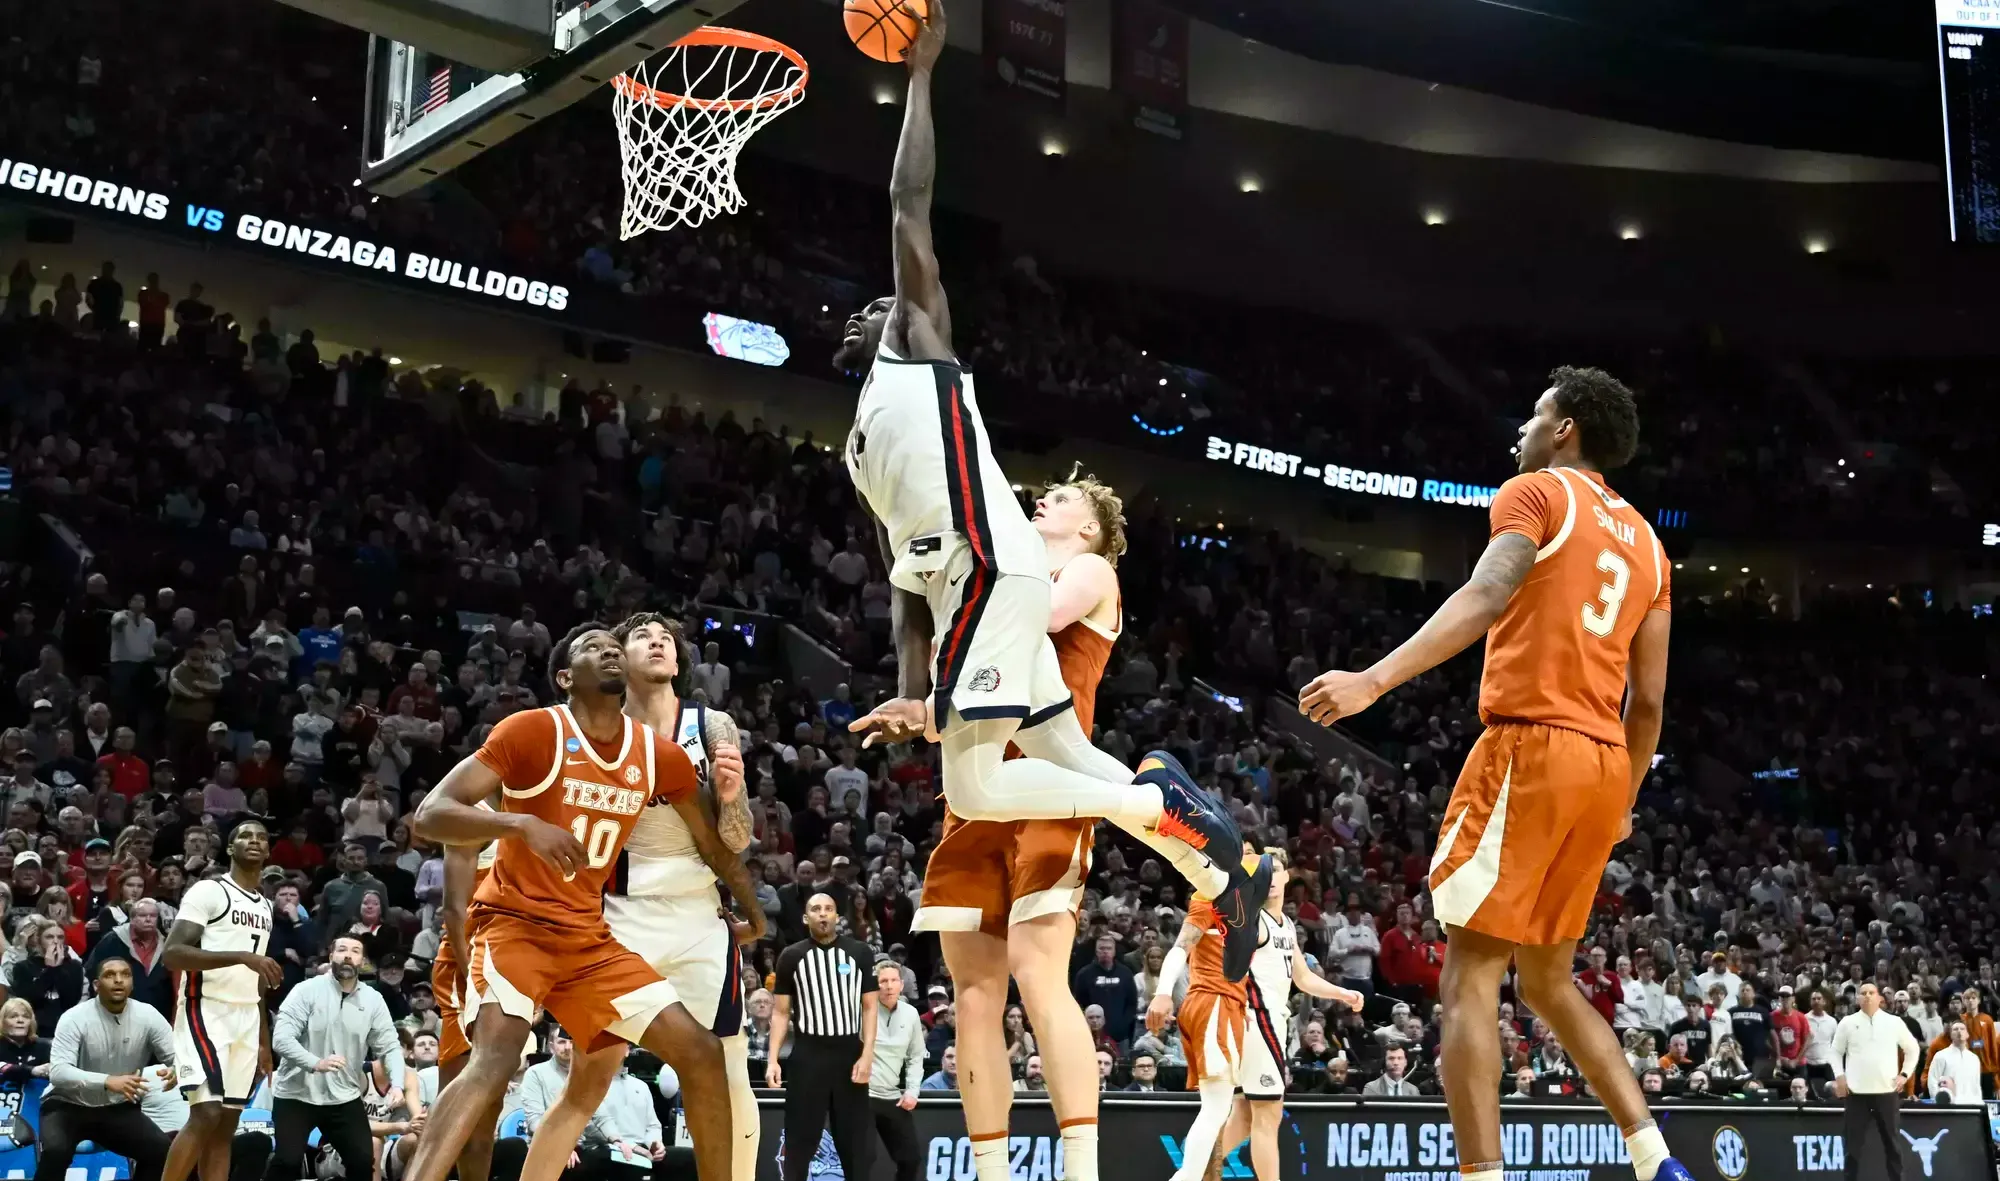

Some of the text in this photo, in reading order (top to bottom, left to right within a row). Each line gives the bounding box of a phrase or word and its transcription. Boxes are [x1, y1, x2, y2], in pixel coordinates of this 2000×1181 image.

[186, 204, 225, 232] VS
[236, 214, 396, 273] GONZAGA
[405, 252, 569, 311] BULLDOGS
[1233, 442, 1302, 477] FIRST
[1323, 463, 1418, 499] SECOND
[1581, 548, 1630, 638] 3
[562, 777, 646, 816] TEXAS
[571, 814, 621, 869] 10
[250, 933, 261, 954] 7
[1326, 1123, 1409, 1167] NCAA
[1418, 1123, 1533, 1166] SEND
[1715, 1129, 1746, 1177] SEC
[1792, 1135, 1845, 1171] TEXA
[1384, 1171, 1430, 1181] HOSTED
